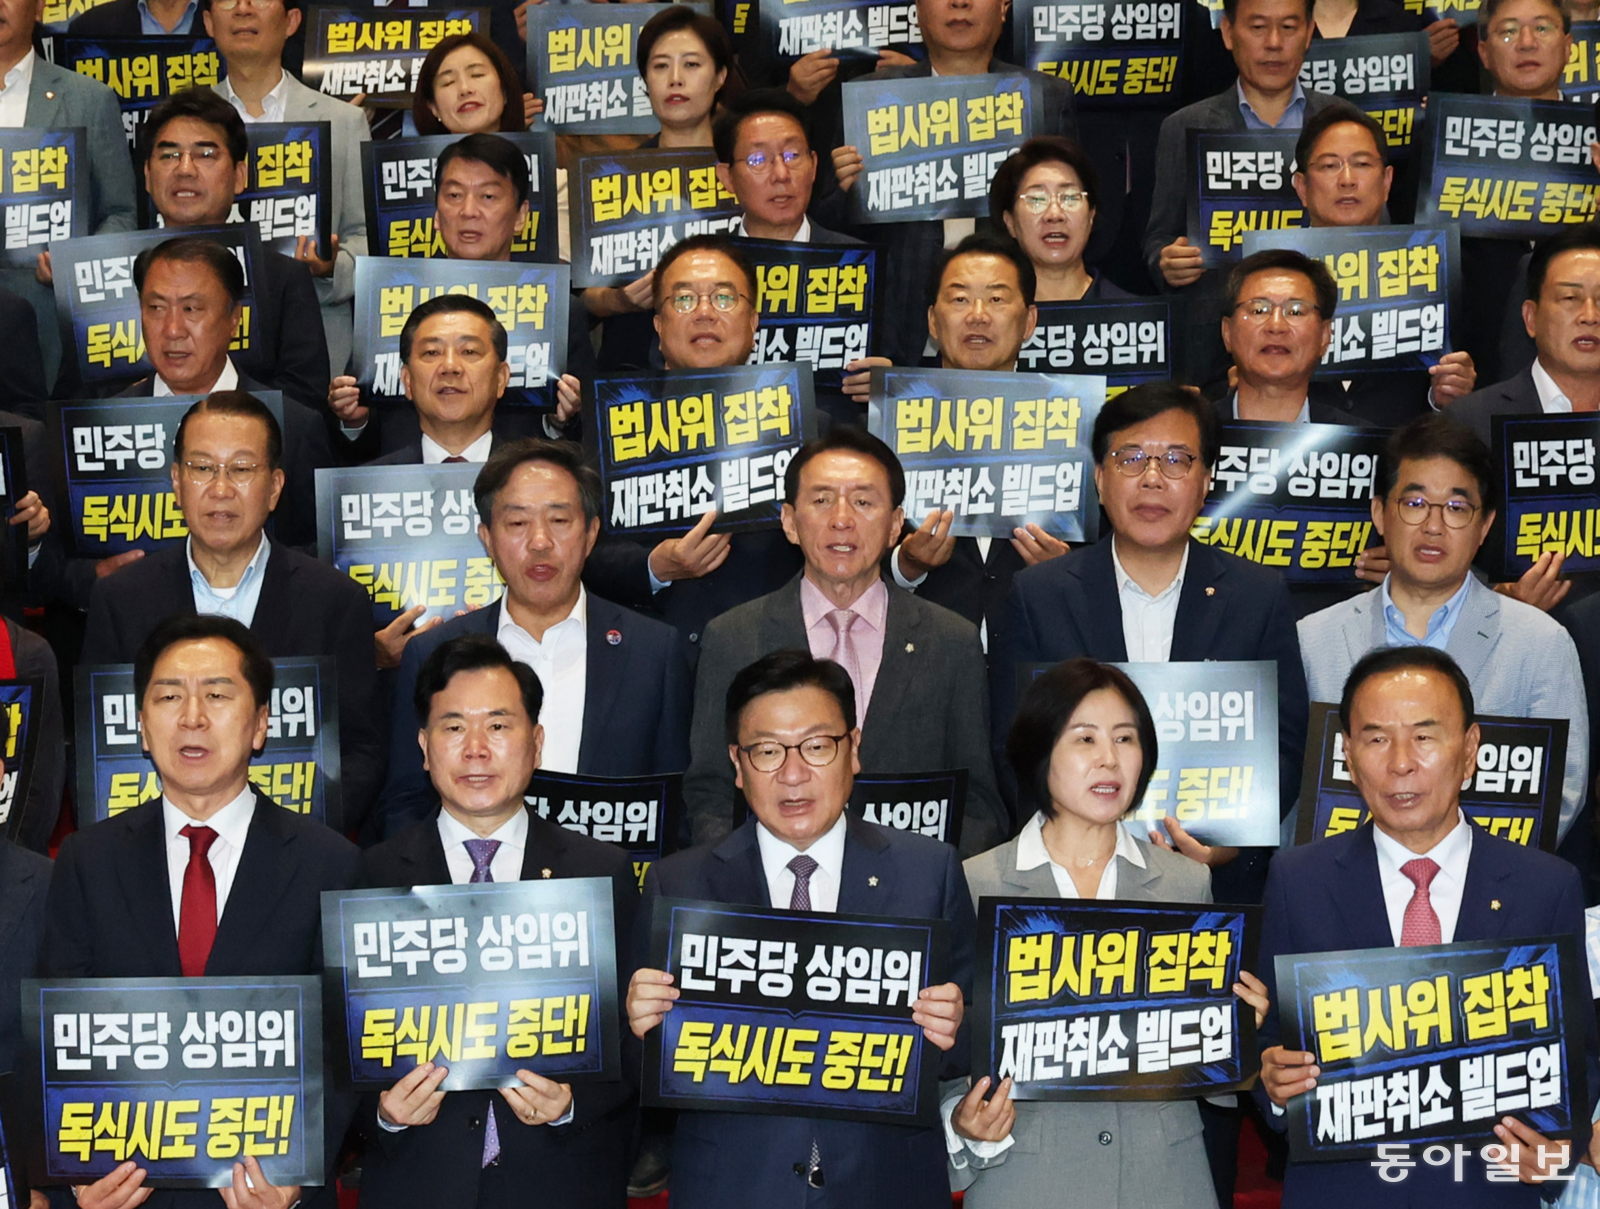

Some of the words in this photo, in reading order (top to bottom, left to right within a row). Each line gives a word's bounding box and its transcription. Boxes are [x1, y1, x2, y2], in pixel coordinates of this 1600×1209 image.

[327, 20, 412, 54] 법사위
[778, 10, 864, 57] 재판취소
[1032, 4, 1106, 42] 민주당
[1110, 3, 1181, 41] 상임위
[547, 23, 631, 73] 법사위
[166, 52, 220, 95] 집착
[320, 60, 406, 96] 재판취소
[1122, 56, 1178, 95] 중단!
[1342, 54, 1415, 95] 상임위
[543, 78, 628, 125] 재판취소
[867, 97, 960, 157] 법사위
[966, 91, 1024, 142] 집착
[1366, 107, 1415, 146] 단!
[1444, 116, 1525, 160] 민주당
[11, 146, 68, 194] 집착
[256, 141, 313, 188] 집착
[382, 158, 438, 200] 민주
[866, 158, 959, 212] 재판취소
[1206, 151, 1284, 191] 민주당
[249, 194, 317, 242] 빌드업
[591, 166, 681, 223] 법사위
[1438, 177, 1540, 221] 독식시도
[4, 200, 72, 249] 빌드업
[74, 255, 138, 303] 민주
[807, 265, 868, 314] 집착
[1377, 245, 1440, 298] 집착
[486, 283, 548, 332] 집착
[1371, 304, 1445, 360] 빌드업
[795, 323, 868, 371] 빌드업
[1013, 324, 1077, 372] 주당
[1081, 321, 1165, 366] 상임위
[73, 423, 167, 471] 민주당
[609, 393, 716, 462] 법사위
[723, 385, 792, 446] 집착
[895, 396, 1004, 454] 법사위
[1012, 396, 1082, 450] 집착
[1208, 446, 1281, 495] 주당
[1287, 451, 1379, 500] 상임위
[1512, 439, 1596, 488] 민주당
[610, 465, 718, 528] 재판취소
[1001, 461, 1083, 517] 빌드업
[341, 490, 435, 540] 민주당
[1516, 509, 1600, 563] 독식시
[1299, 521, 1373, 569] 중단!
[1153, 690, 1255, 742] 상임위
[1175, 766, 1255, 822] 중단!
[1461, 743, 1544, 795] 임위
[556, 800, 659, 842] 상임위
[353, 917, 469, 978] 민주당
[477, 911, 591, 972] 상임위
[1008, 931, 1140, 1003] 법사위
[1148, 931, 1233, 994] 집착
[680, 933, 799, 998] 민주당
[805, 944, 922, 1008] 상임위
[361, 1001, 499, 1068] 독식시도
[506, 994, 591, 1059] 중단!
[1313, 975, 1453, 1063] 법사위
[1462, 964, 1550, 1040] 집착
[53, 1012, 172, 1071] 민주당
[179, 1010, 296, 1069] 상임위
[673, 1021, 820, 1086] 독식시도
[821, 1030, 915, 1093] 중단!
[998, 1014, 1130, 1083] 재판취소
[1136, 1004, 1233, 1074] 빌드업
[1316, 1064, 1454, 1143] 재판취소
[1459, 1042, 1561, 1122] 빌드업
[59, 1099, 200, 1162] 독식시도
[206, 1095, 296, 1159] 중단!
